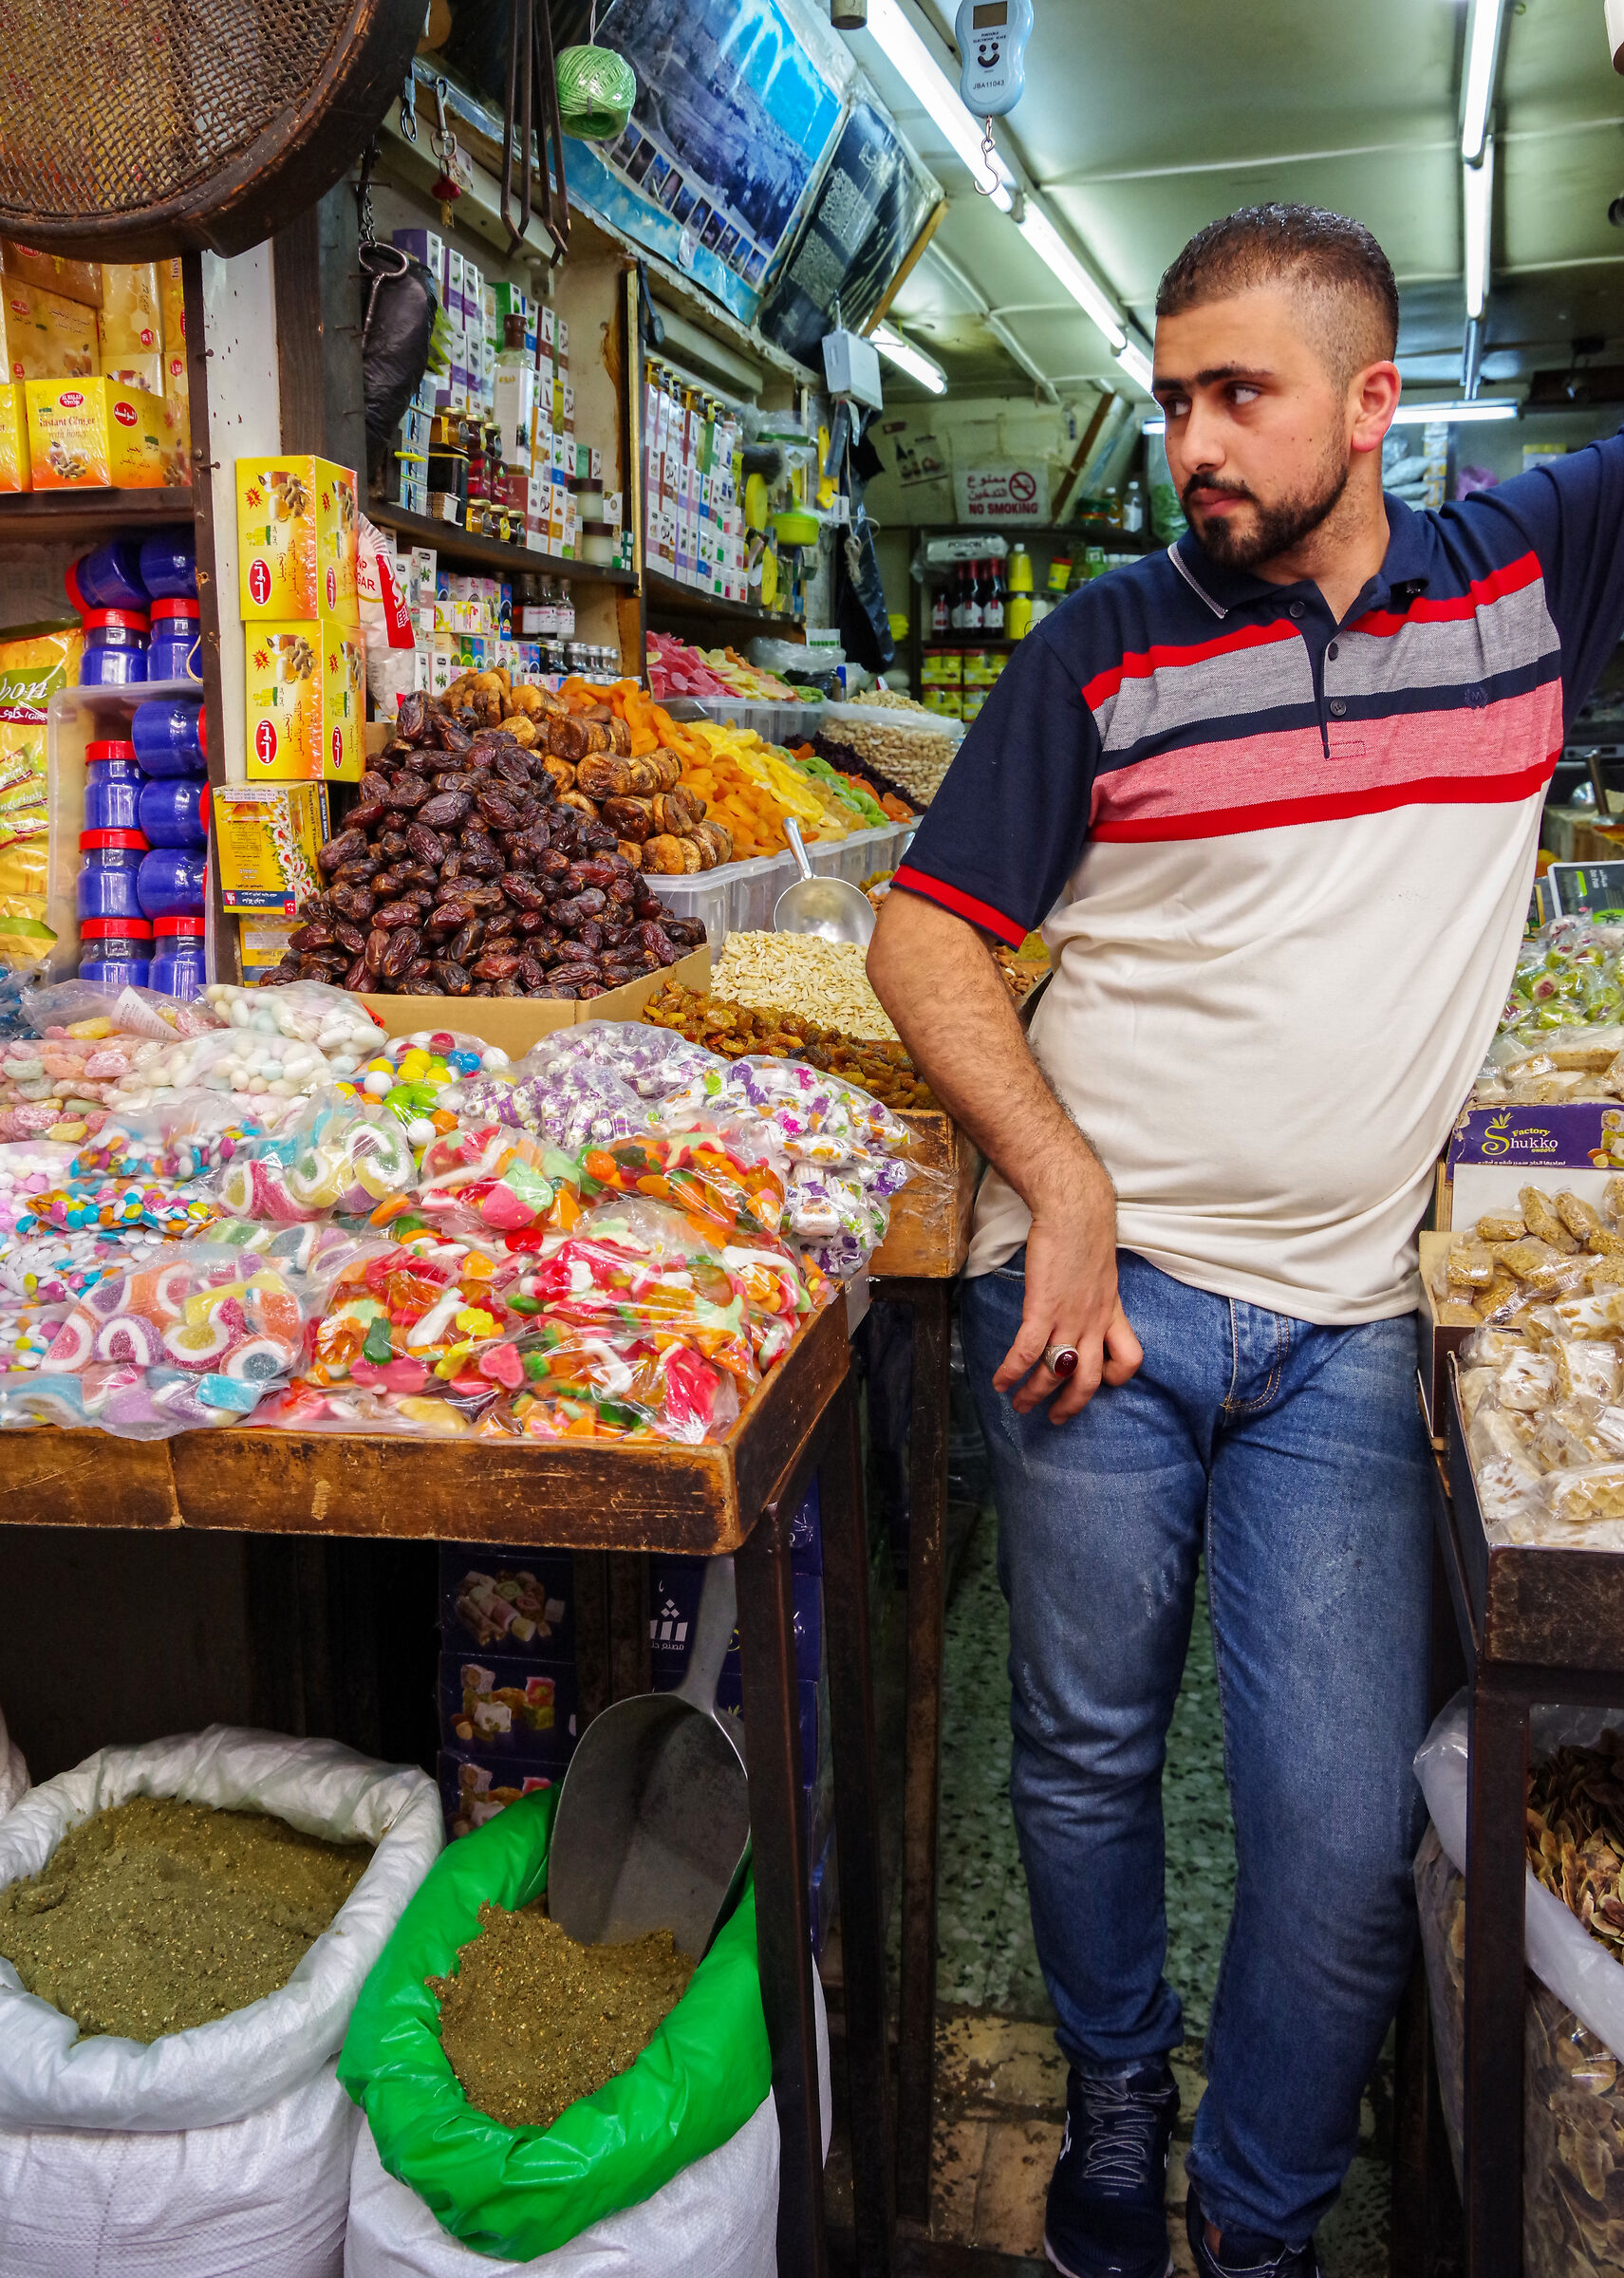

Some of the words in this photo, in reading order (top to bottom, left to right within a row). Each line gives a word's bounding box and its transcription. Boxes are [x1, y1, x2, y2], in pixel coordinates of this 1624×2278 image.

[973, 80, 1005, 89] JBA11043
[68, 416, 96, 427] Ginger
[969, 503, 984, 514] NO
[987, 502, 1038, 514] SMOKING
[253, 561, 266, 603] الولد
[260, 721, 272, 763] الولد
[1512, 1128, 1551, 1137] Factory
[1482, 1124, 1559, 1155] Shukko
